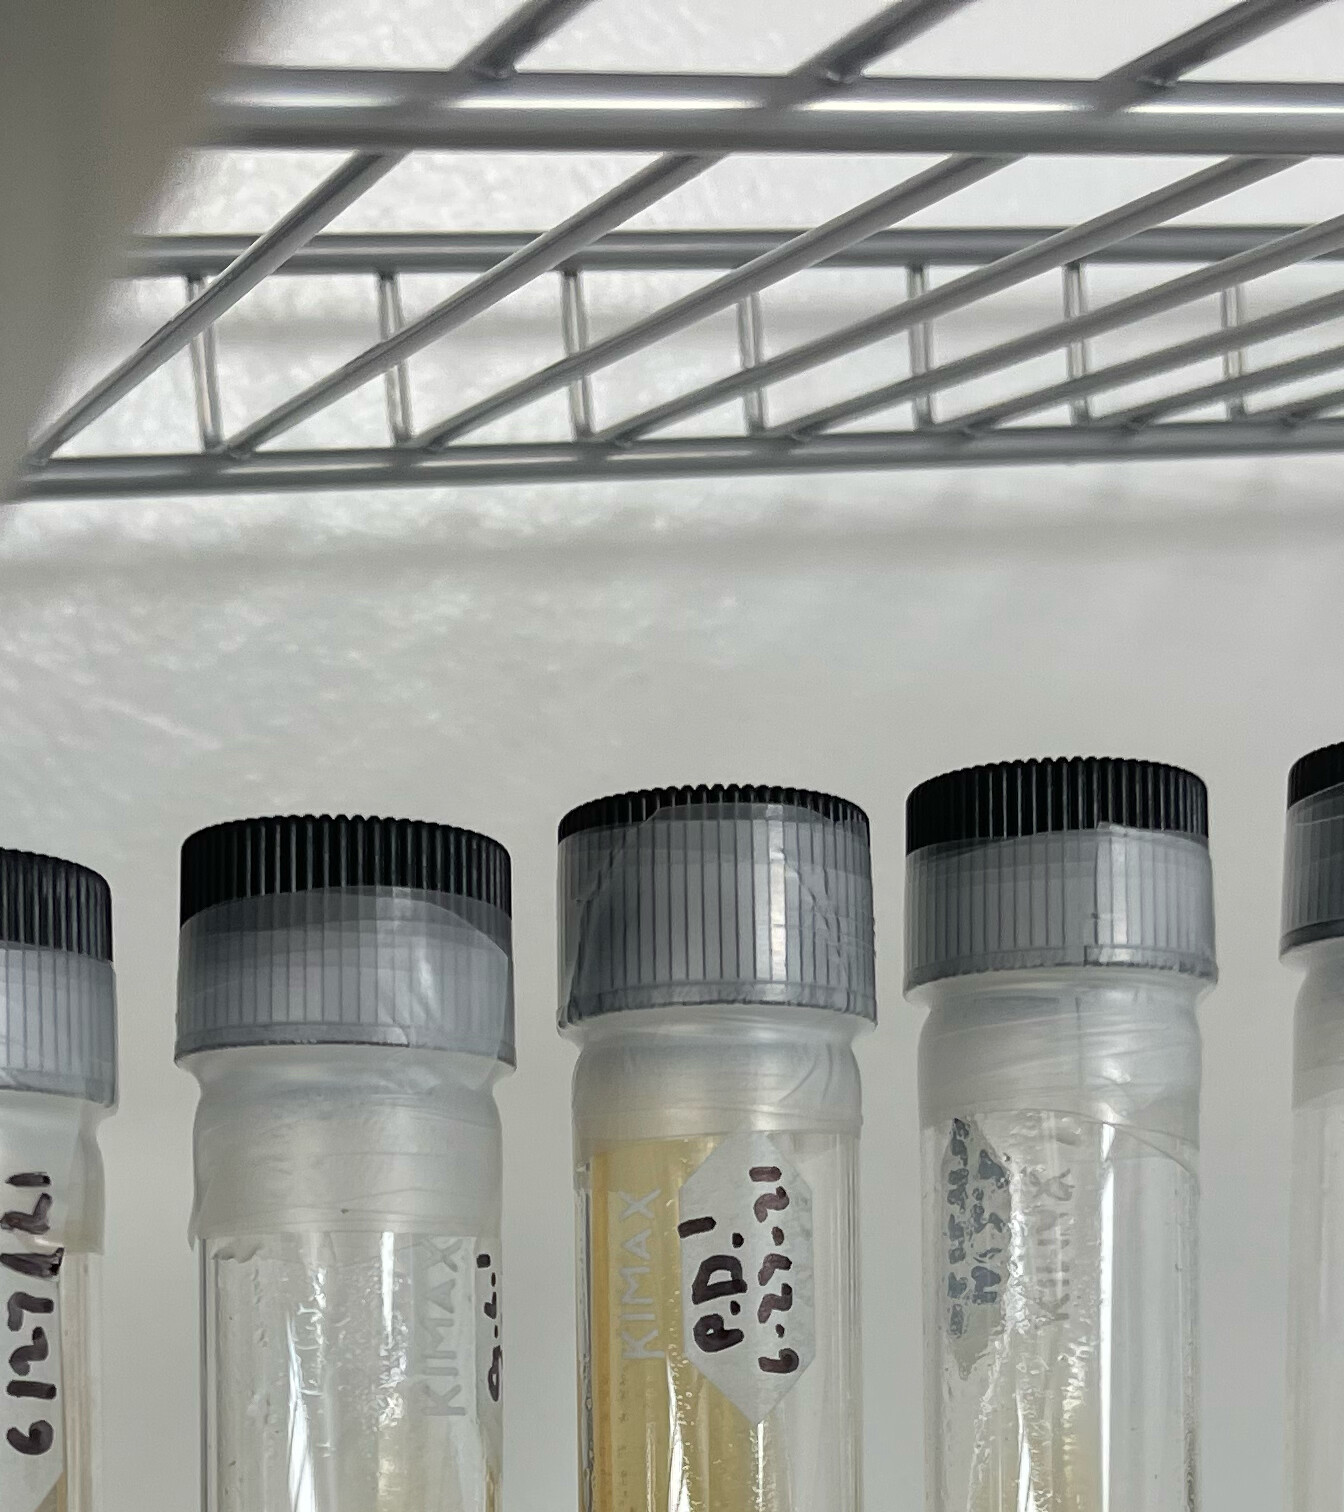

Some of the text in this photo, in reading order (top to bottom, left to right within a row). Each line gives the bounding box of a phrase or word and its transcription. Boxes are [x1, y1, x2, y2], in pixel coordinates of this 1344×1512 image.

[422, 1236, 466, 1418] KIMAX
[617, 1187, 665, 1360] KIMAX
[748, 1165, 800, 1374] 6-27-21
